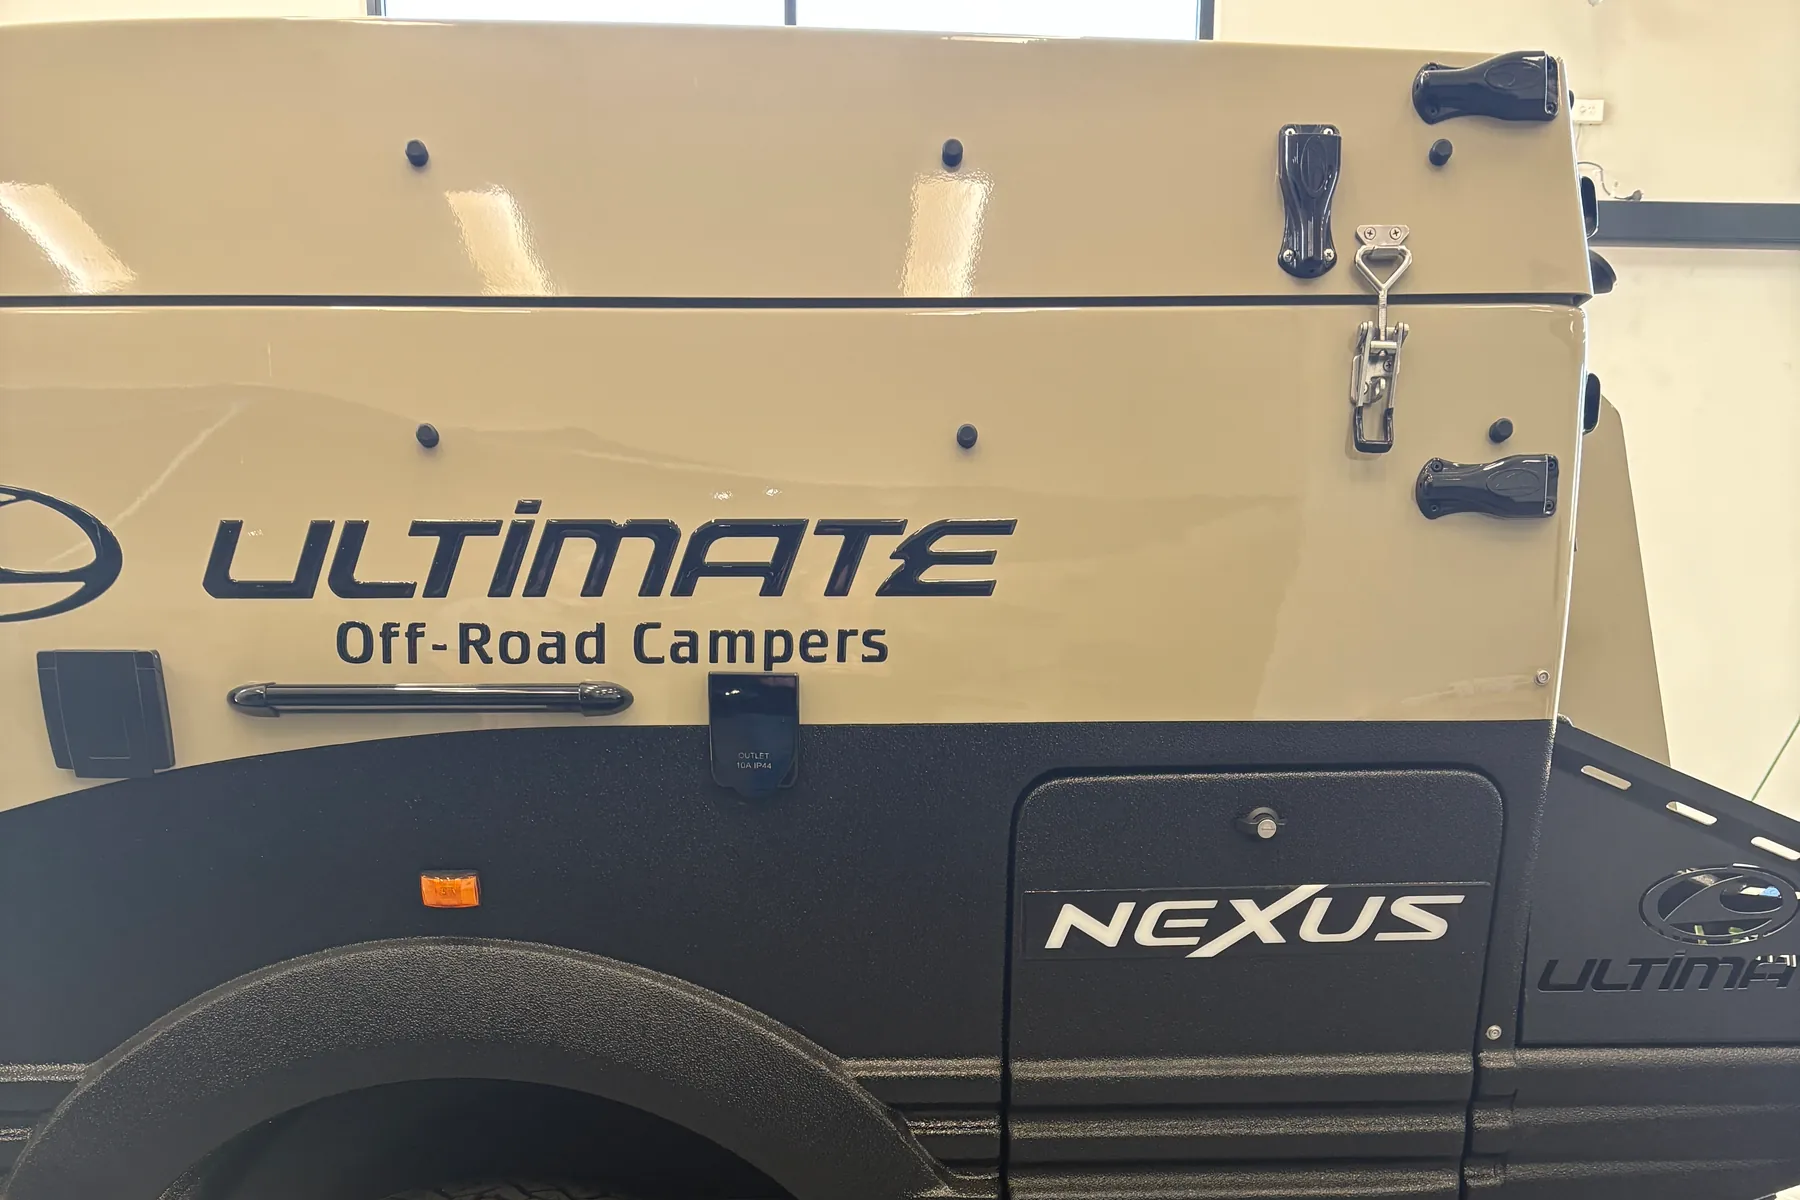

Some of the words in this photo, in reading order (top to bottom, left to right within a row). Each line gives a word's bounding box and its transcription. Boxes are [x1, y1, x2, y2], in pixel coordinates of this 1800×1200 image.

[335, 620, 607, 666] Off-Road
[632, 620, 889, 672] Campers
[736, 761, 752, 770] 10A
[753, 761, 772, 770] IP44
[738, 752, 770, 760] OUTLET
[1044, 884, 1466, 959] NEXUS
[1537, 950, 1800, 993] ULTIMA
